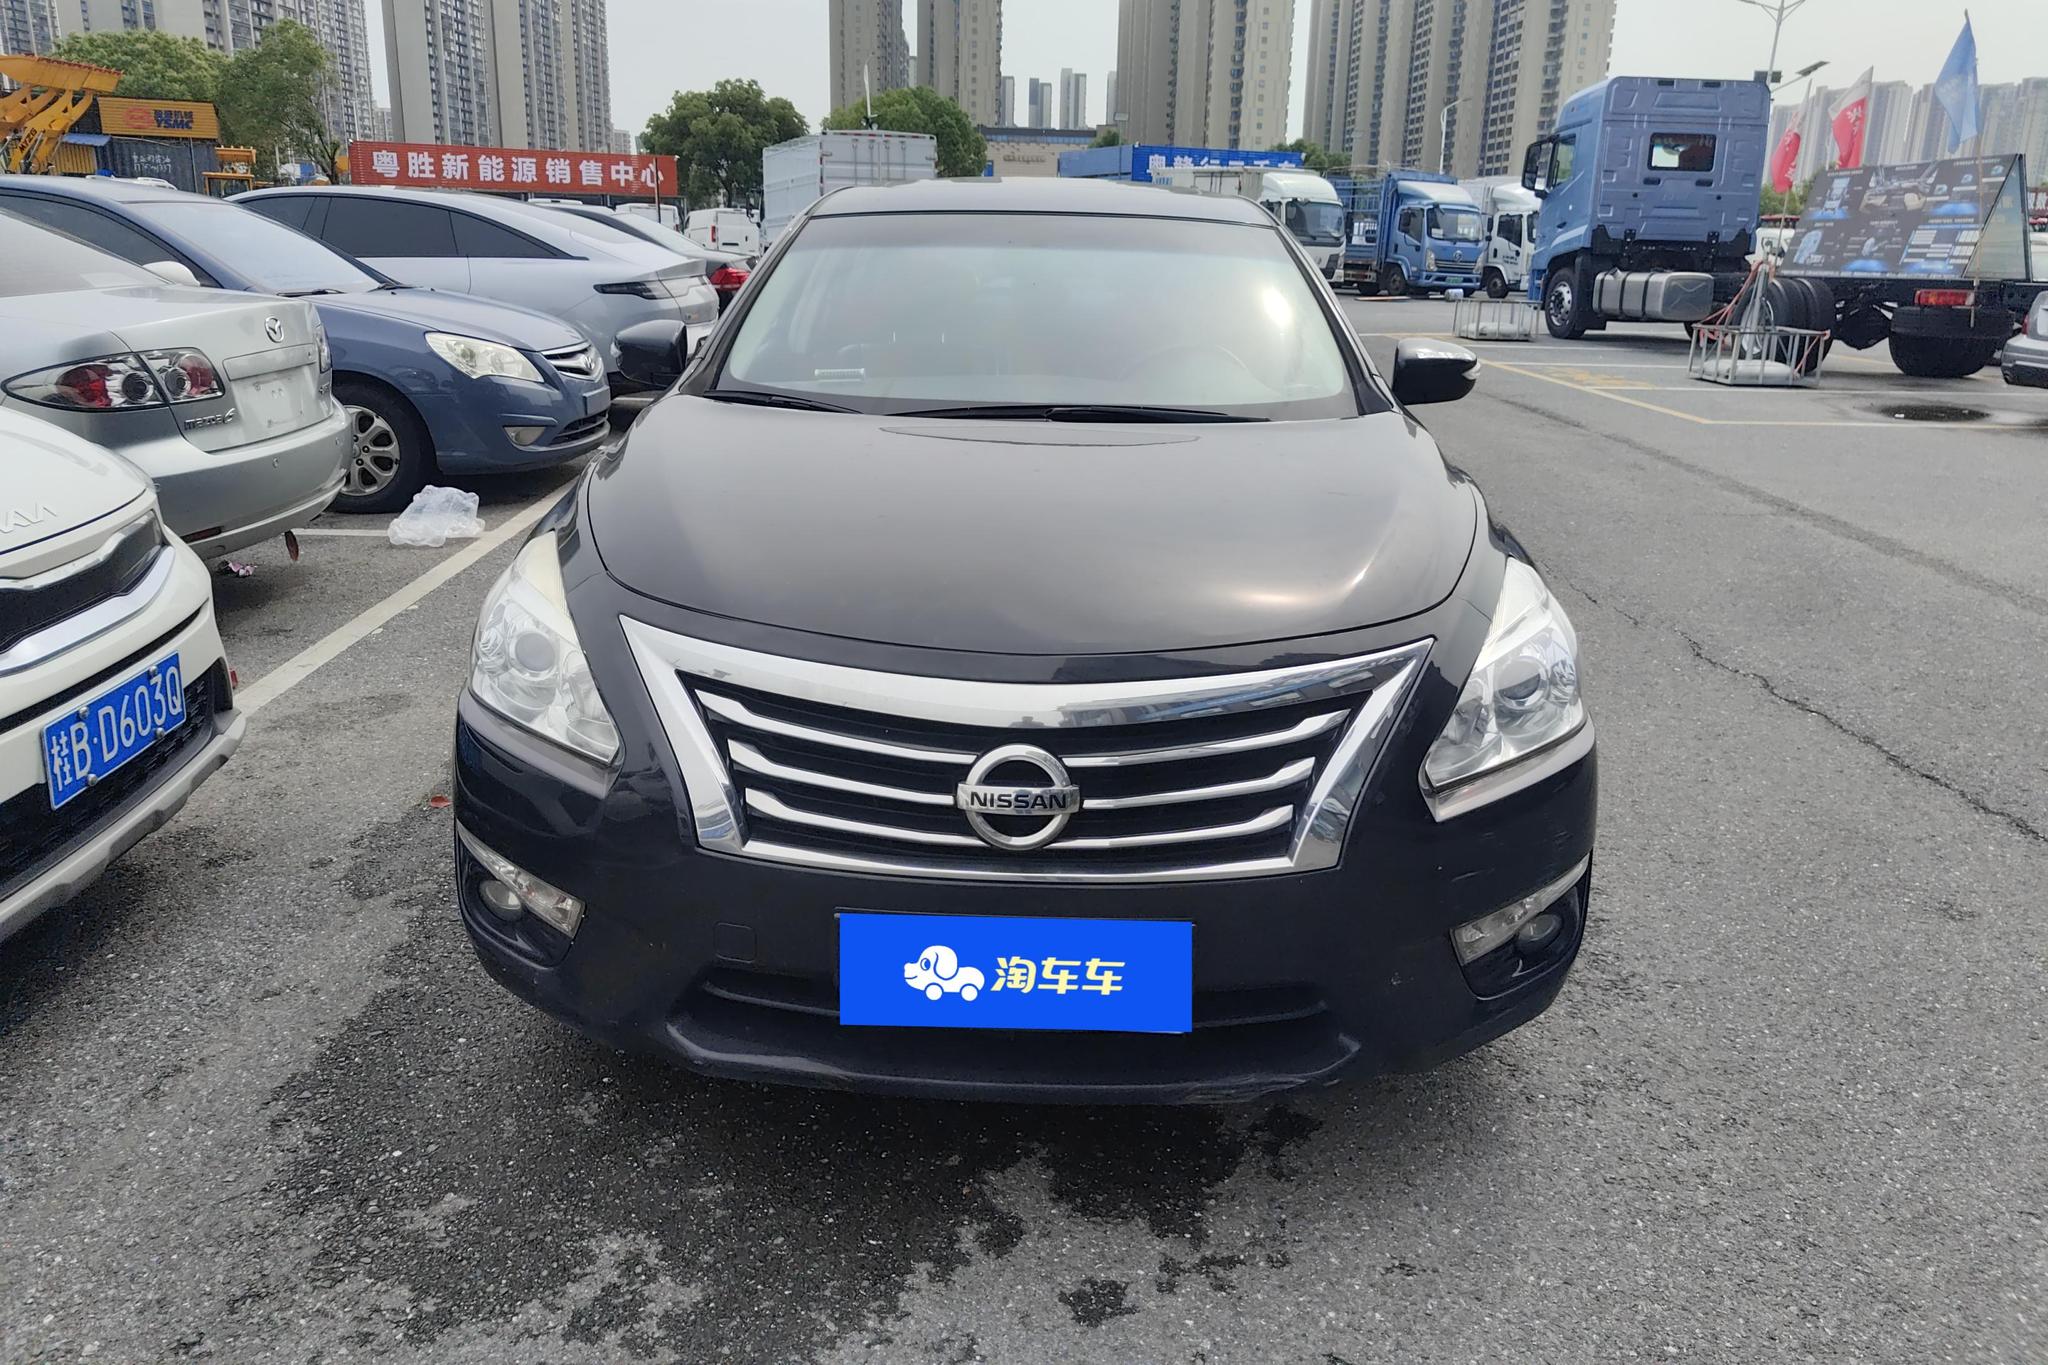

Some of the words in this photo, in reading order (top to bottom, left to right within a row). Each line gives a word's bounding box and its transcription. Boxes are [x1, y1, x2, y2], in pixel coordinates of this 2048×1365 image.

[371, 150, 664, 187] 粤胜新能源销售中心
[969, 791, 1067, 810] NISSAN
